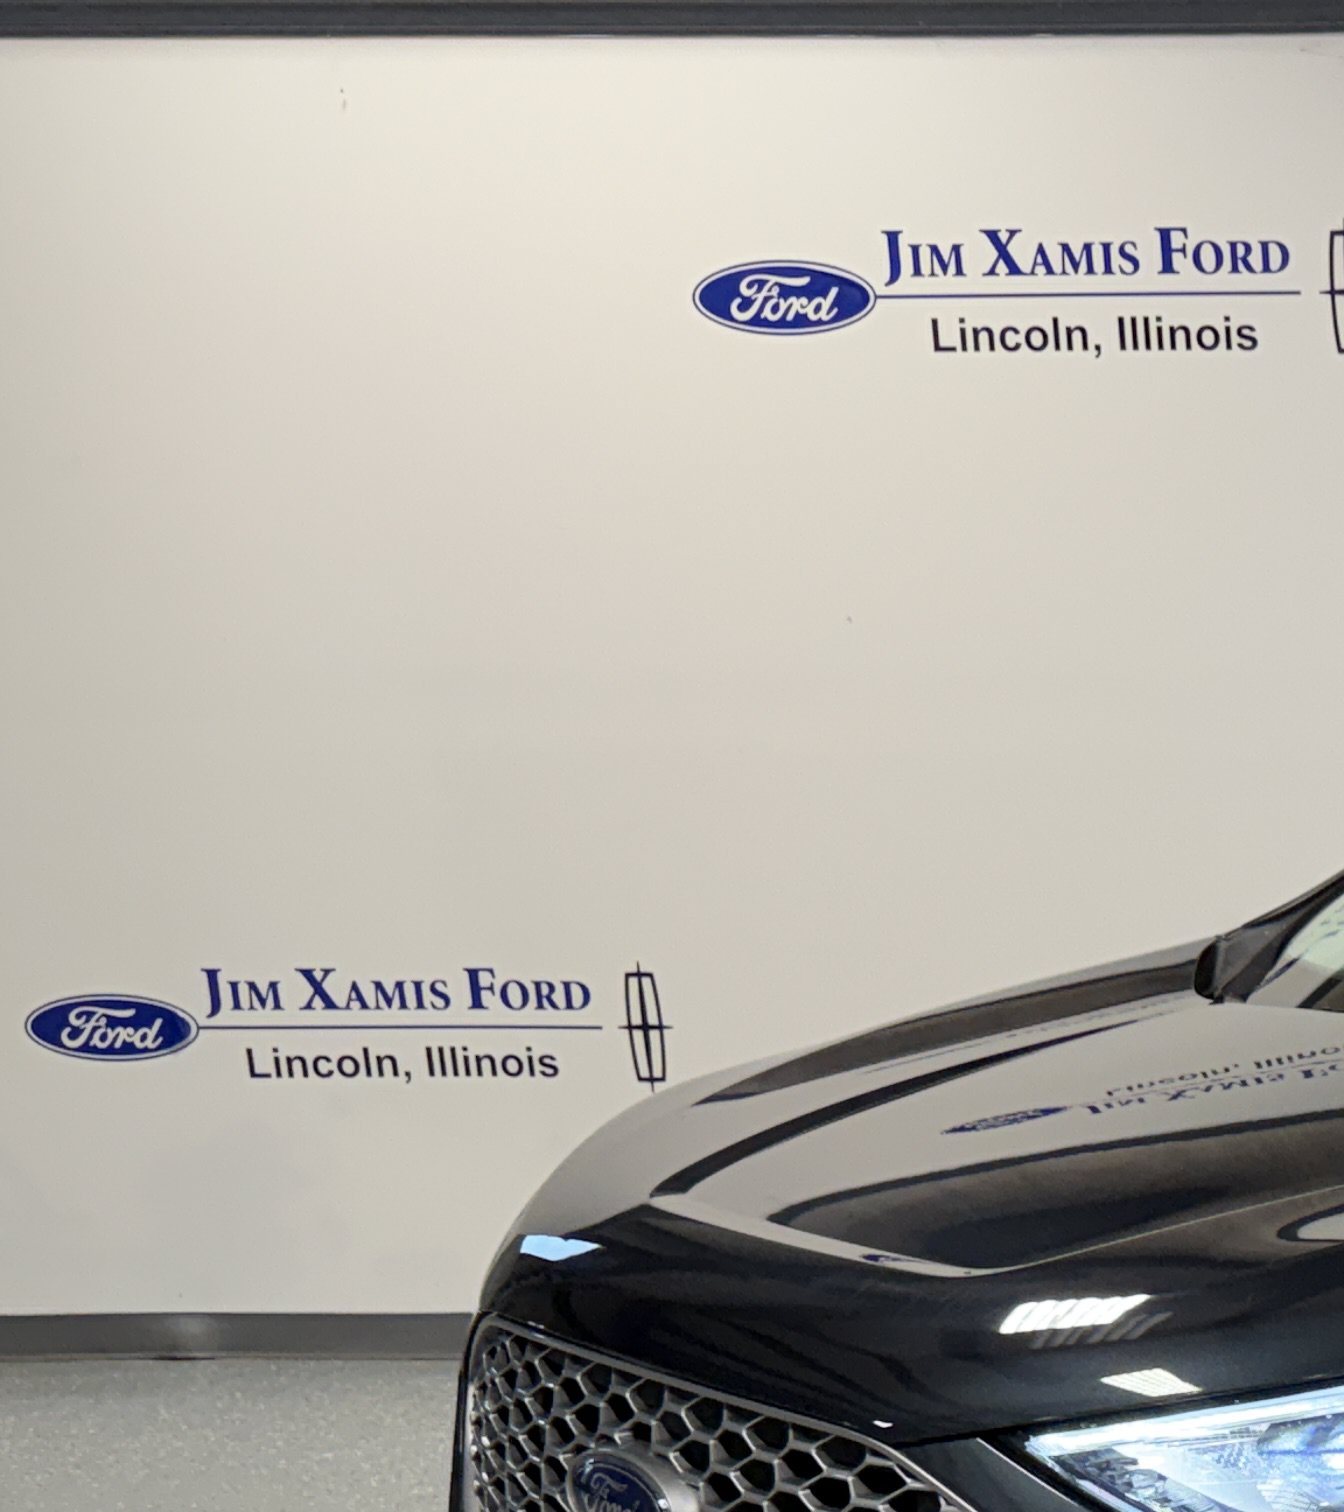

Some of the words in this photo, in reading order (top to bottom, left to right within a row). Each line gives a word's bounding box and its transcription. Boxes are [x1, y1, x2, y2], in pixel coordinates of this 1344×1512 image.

[881, 230, 965, 286] JIM
[979, 229, 1139, 277] XAMIS
[1154, 226, 1291, 276] FORD
[730, 273, 840, 325] Ford
[931, 317, 1101, 358] Lincoln,
[1118, 316, 1259, 352] Illinois
[201, 968, 283, 1020] JIM
[295, 968, 452, 1011] XAMIS
[463, 967, 592, 1011] FORD
[60, 1005, 164, 1050] Ford
[246, 1047, 412, 1083] Lincoln,
[425, 1046, 560, 1078] Illinois
